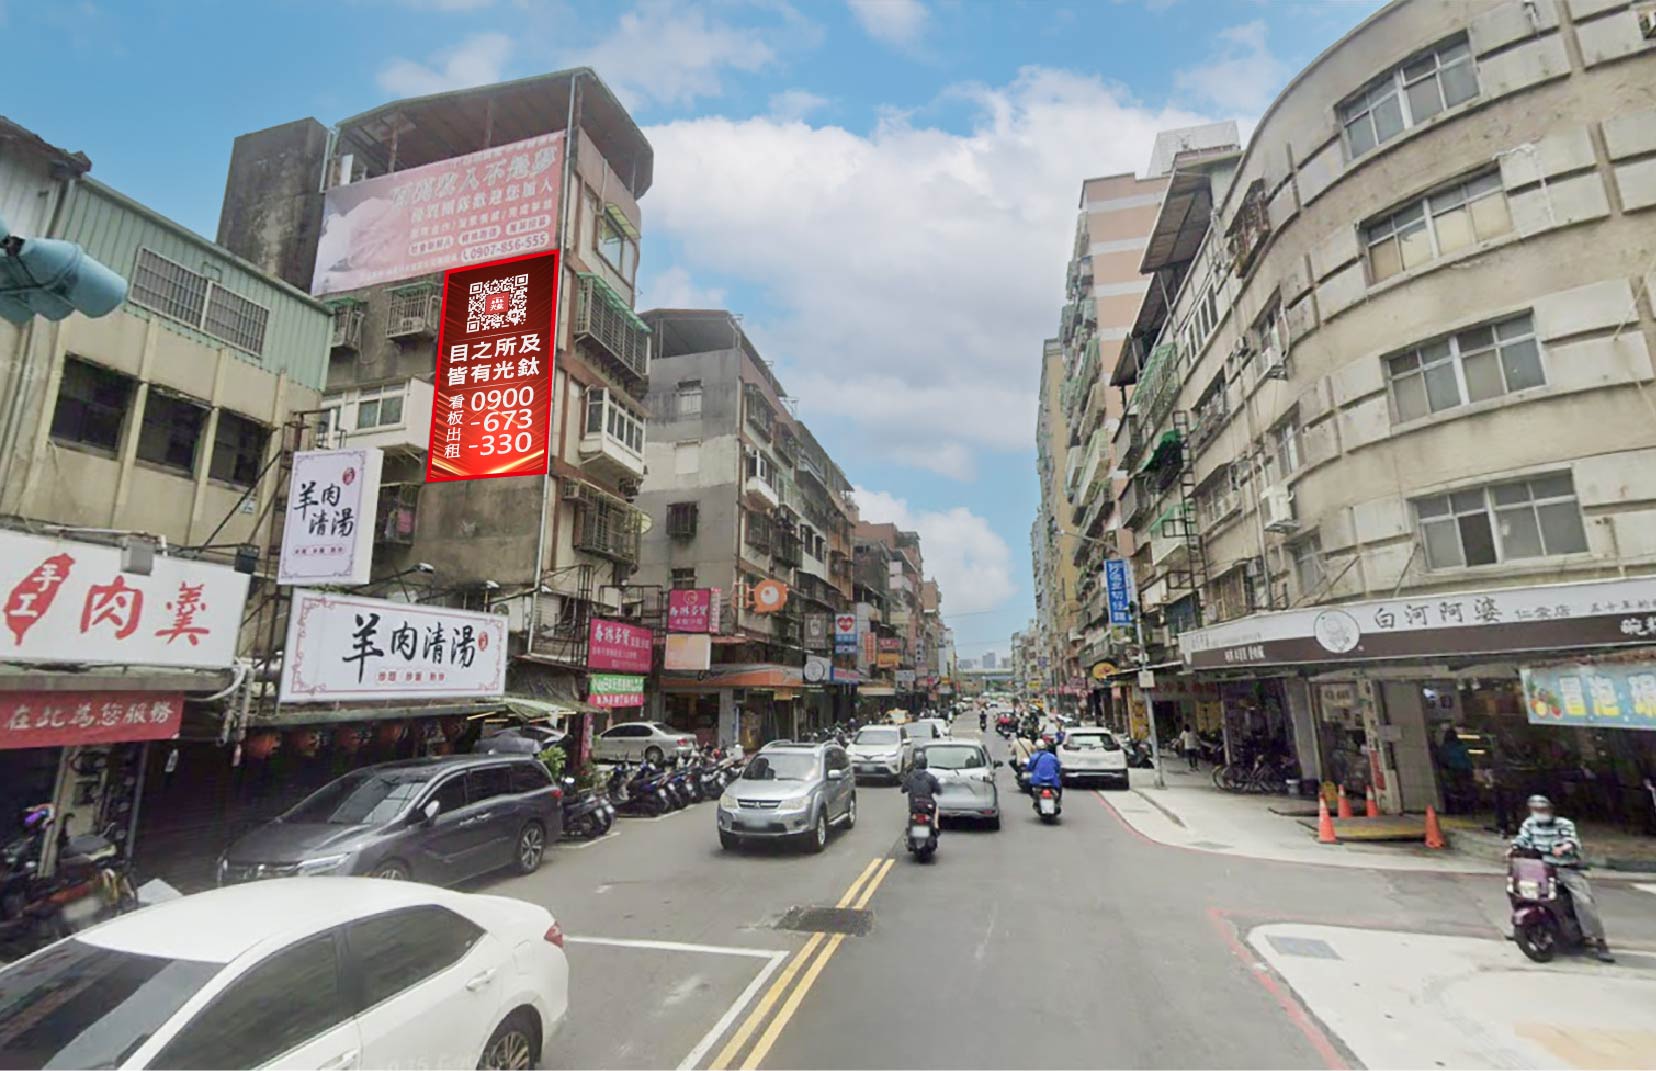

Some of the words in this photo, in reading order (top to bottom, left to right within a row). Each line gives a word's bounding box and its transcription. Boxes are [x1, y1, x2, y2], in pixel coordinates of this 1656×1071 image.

[450, 333, 541, 363] 目之所及
[447, 357, 540, 387] 皆有光鈦
[470, 385, 534, 412] 0900
[444, 394, 465, 459] 看板出租
[471, 408, 533, 433] -673
[468, 431, 532, 456] -330
[294, 481, 341, 520] 羊肉
[308, 507, 354, 536] 清湯
[9, 564, 63, 617] 手工
[80, 575, 210, 646] 肉羹
[1375, 597, 1502, 629] 白河阿婆
[342, 612, 478, 684] 羊肉清湯
